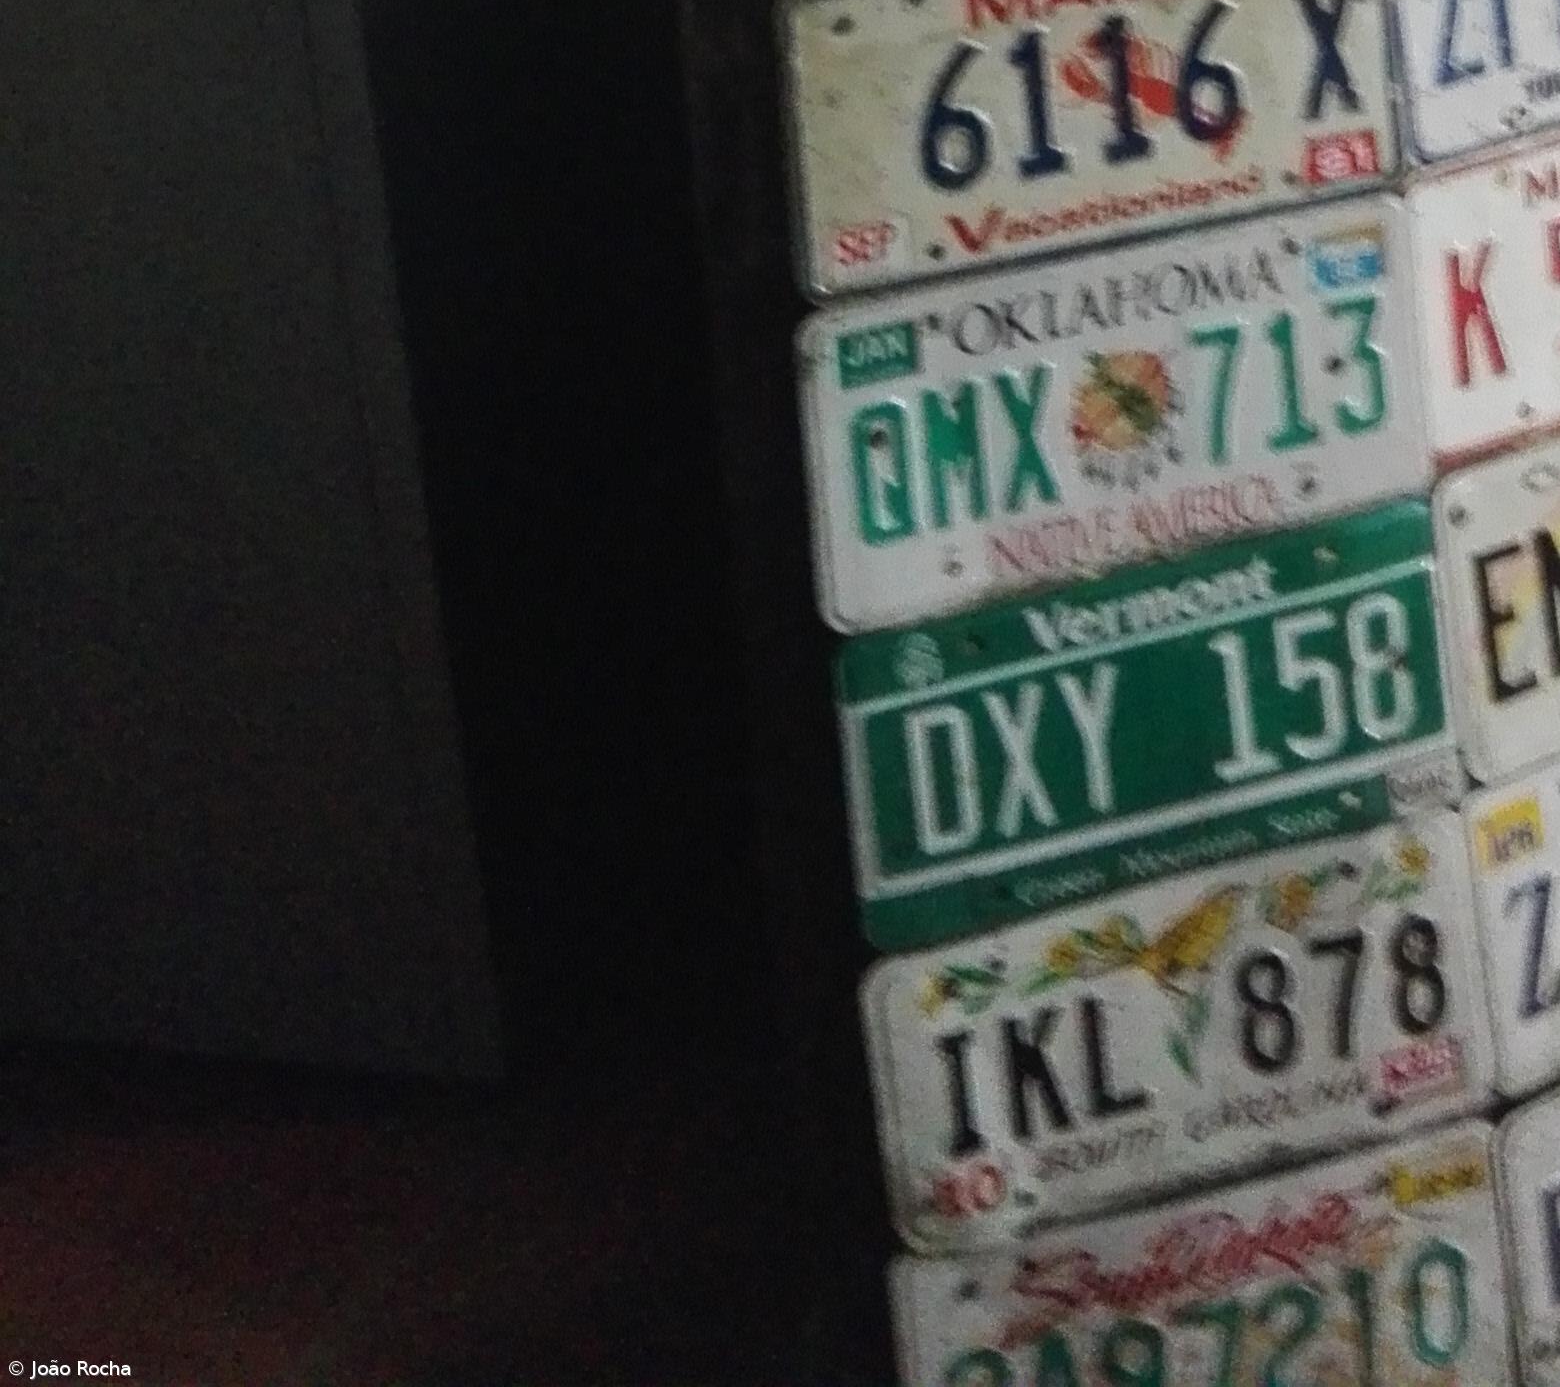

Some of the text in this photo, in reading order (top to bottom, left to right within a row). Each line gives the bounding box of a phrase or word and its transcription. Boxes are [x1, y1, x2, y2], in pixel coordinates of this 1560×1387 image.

[920, 0, 1240, 190] 6116
[945, 165, 1266, 255] Vacationland
[951, 248, 1283, 355] OKLAHOMA
[1190, 295, 1388, 465] 713
[1445, 237, 1507, 392] K
[1023, 557, 1279, 653] Vermont
[905, 589, 1420, 857] DXY 158
[936, 913, 1447, 1159] IKL 878
